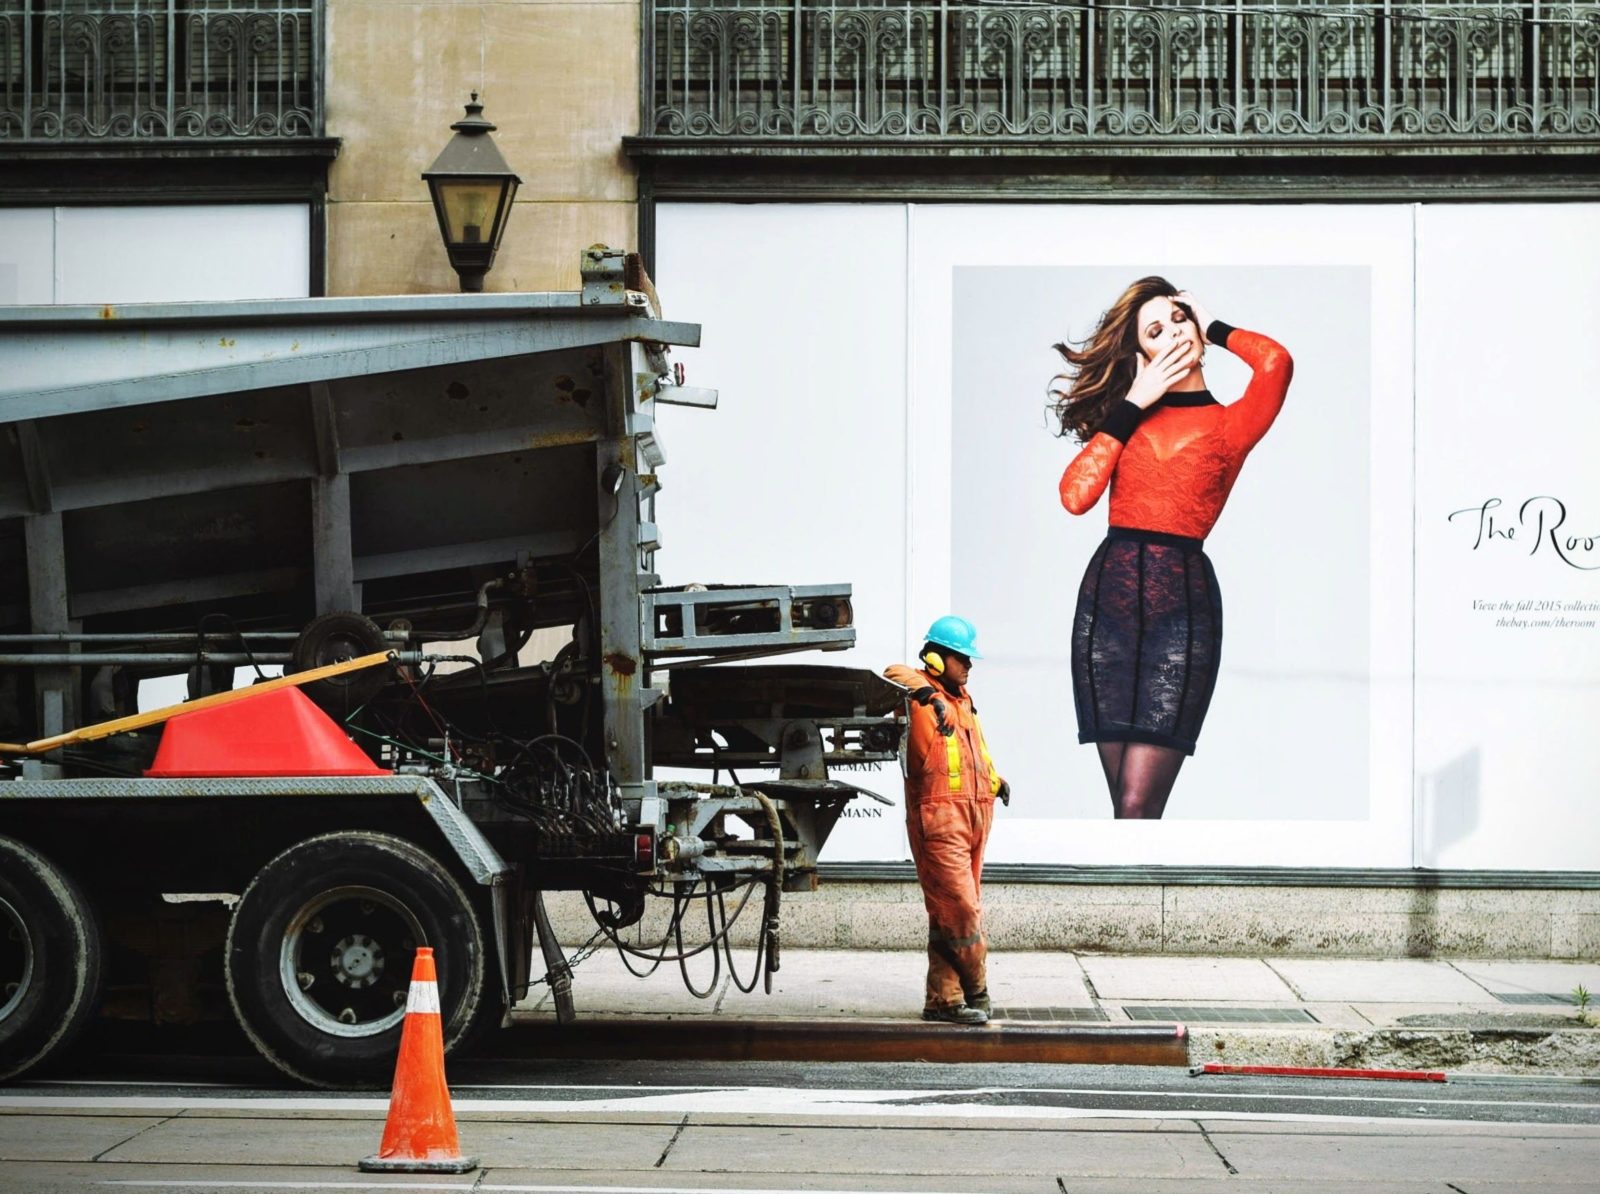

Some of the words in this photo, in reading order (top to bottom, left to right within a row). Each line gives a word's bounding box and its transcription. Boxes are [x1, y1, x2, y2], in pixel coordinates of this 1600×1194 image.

[1448, 498, 1516, 550] The
[1473, 600, 1497, 610] View
[1499, 600, 1514, 610] the
[1514, 600, 1533, 613] fall
[1534, 600, 1562, 611] 2015
[1496, 617, 1595, 630] thebay.com/theroom
